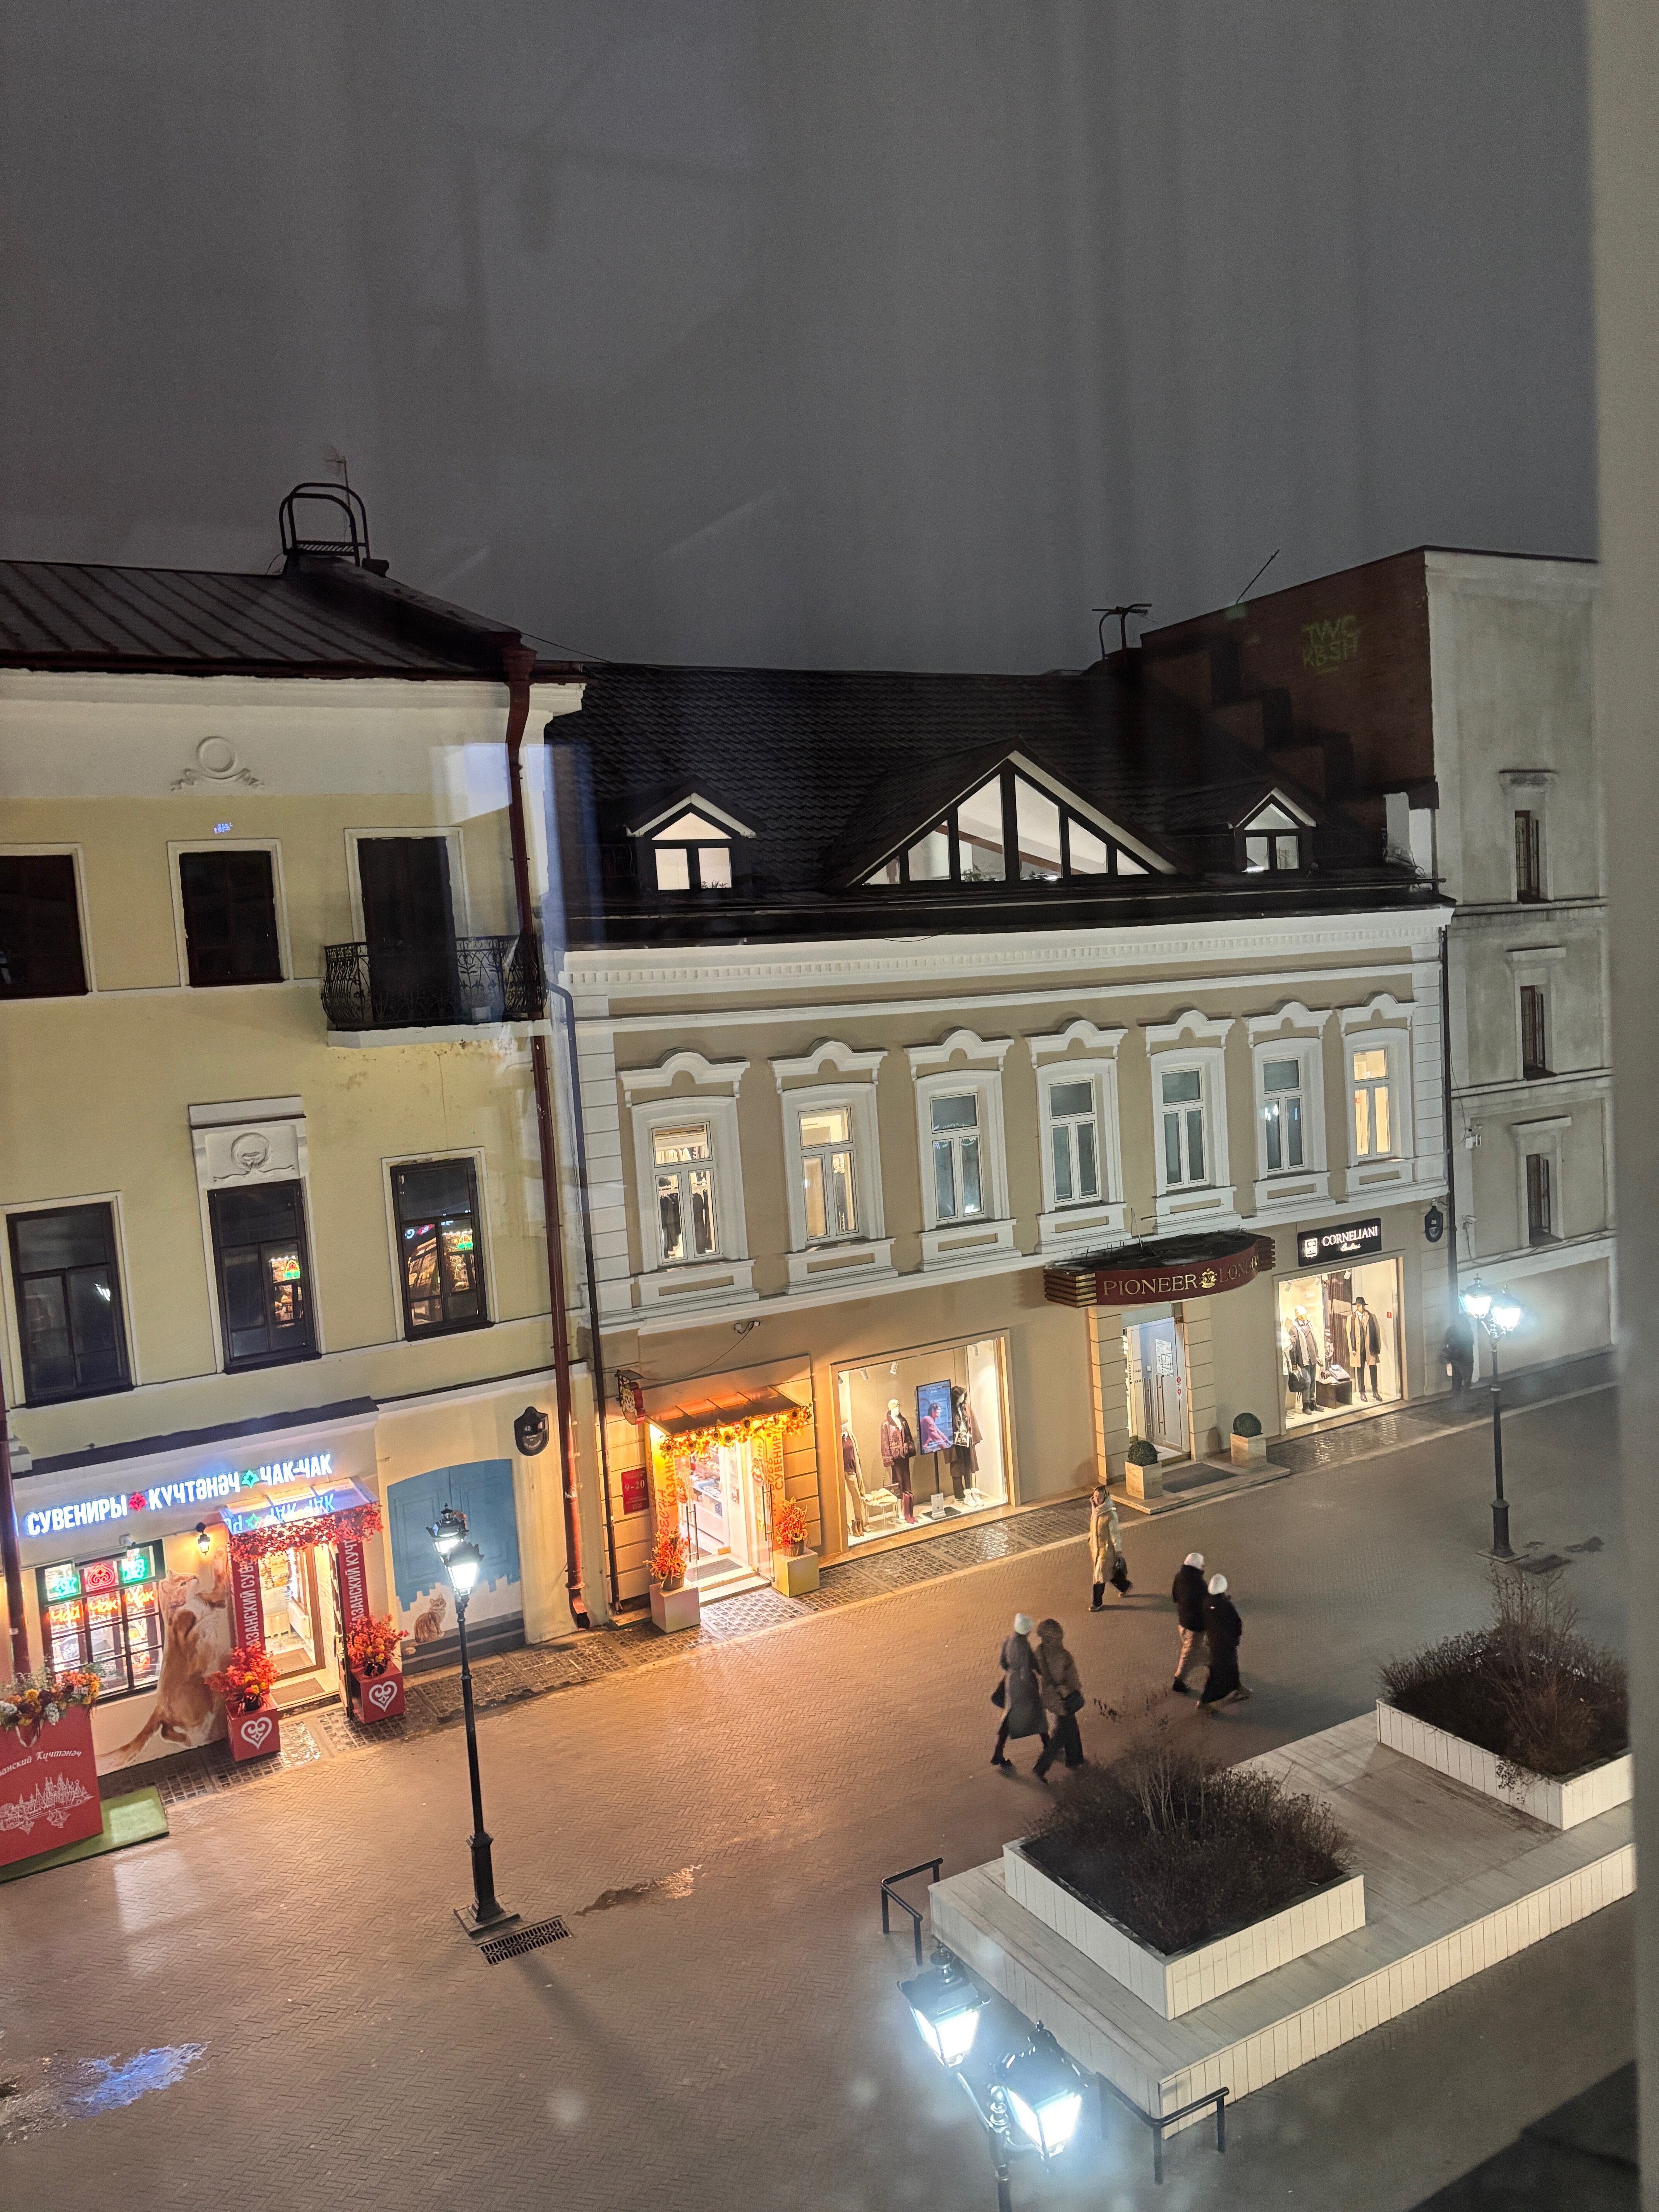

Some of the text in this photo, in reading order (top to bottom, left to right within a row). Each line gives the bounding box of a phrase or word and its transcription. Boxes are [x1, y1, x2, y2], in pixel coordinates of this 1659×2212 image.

[1322, 1226, 1378, 1247] CORNELIANI
[1103, 1274, 1197, 1295] PIONEER
[27, 1494, 128, 1536] СУВЕНИРЫ
[260, 1453, 332, 1486] ЧАК-ЧАК
[665, 1456, 677, 1507] КАЗАНЬ
[240, 1589, 259, 1646] АЗАНСКИЙ
[345, 1567, 364, 1628] АЗАНСКИЙ
